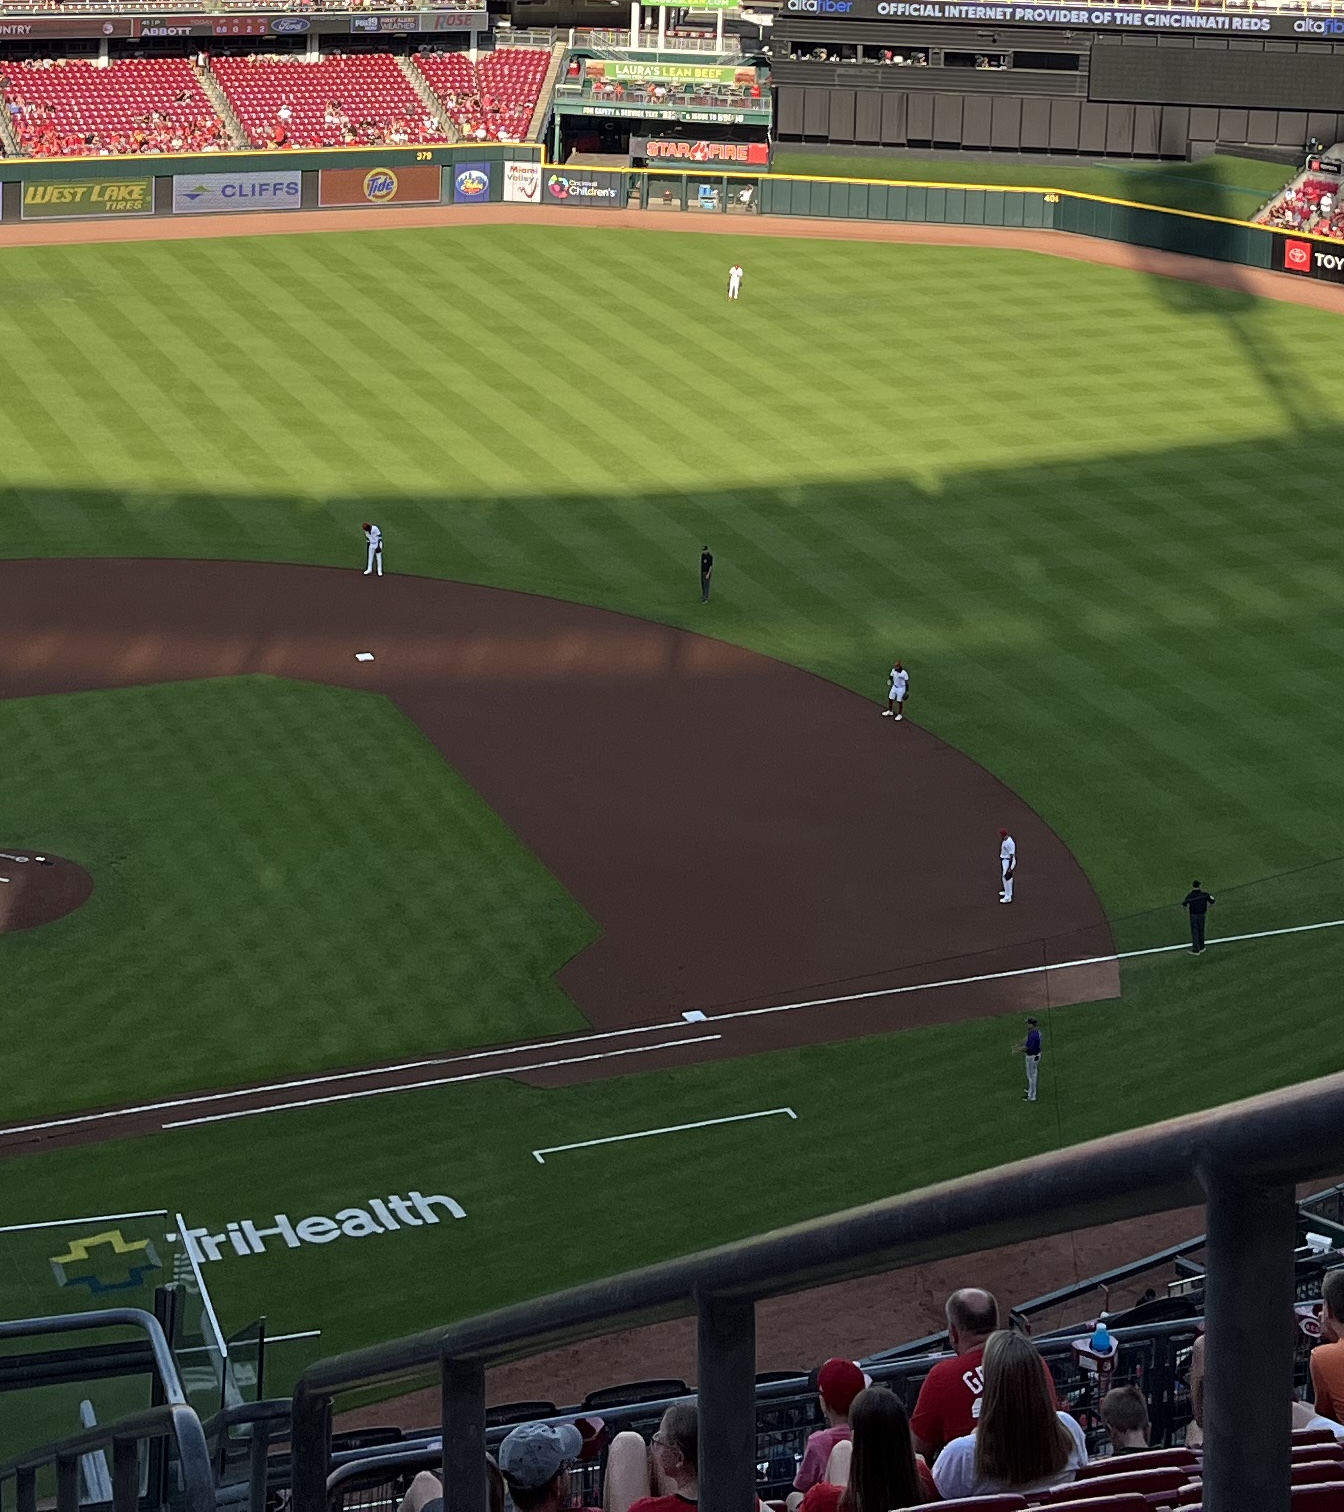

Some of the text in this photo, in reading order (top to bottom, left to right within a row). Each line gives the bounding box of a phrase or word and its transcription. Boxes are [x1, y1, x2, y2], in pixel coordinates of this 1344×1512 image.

[435, 13, 473, 30] ROSE
[877, 1, 943, 17] OFFICIAL
[945, 5, 1012, 20] INTERNET
[1015, 8, 1088, 23] PROVIDER
[1091, 12, 1111, 24] OF
[1116, 13, 1141, 26] THE
[1143, 14, 1229, 29] CINCINNATI
[1232, 17, 1271, 31] REDS
[141, 26, 193, 36] ABBOTT
[279, 19, 304, 31] Ford
[615, 64, 661, 76] LAURA'S
[663, 67, 692, 77] LEAN
[695, 69, 722, 79] BEEF
[647, 141, 748, 160] STAR FIRE
[509, 165, 539, 175] Miami
[367, 175, 394, 197] Tide
[506, 173, 536, 184] Valley
[25, 184, 146, 204] WEST LAKE
[220, 181, 299, 198] CLIFFS
[569, 187, 617, 198] Children's
[105, 200, 142, 211] TIRES
[167, 1191, 467, 1263] TriHealth
